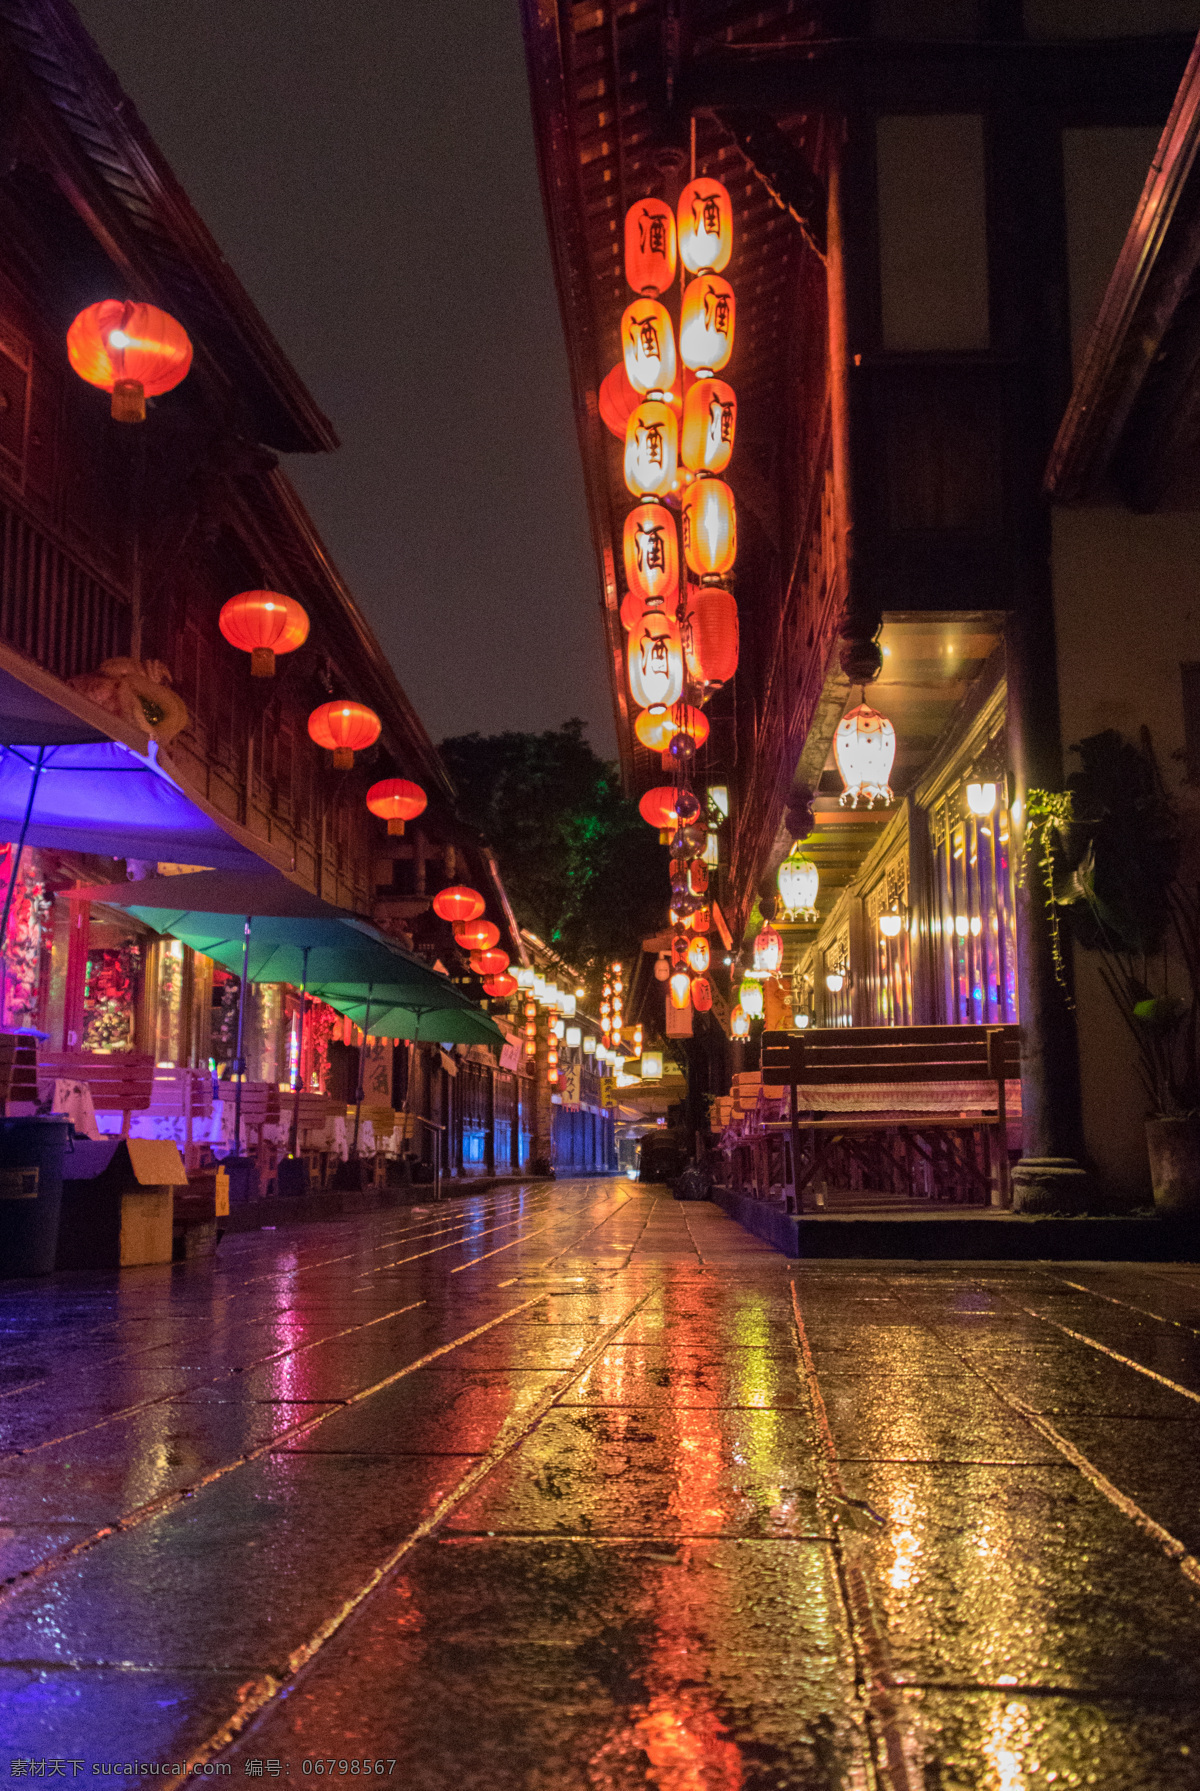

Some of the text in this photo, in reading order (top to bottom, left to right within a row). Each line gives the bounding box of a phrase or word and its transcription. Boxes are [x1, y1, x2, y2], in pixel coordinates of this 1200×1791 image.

[638, 208, 668, 260] 酒
[691, 191, 721, 239] 酒
[703, 284, 731, 338] 酒
[629, 315, 662, 362] 酒
[634, 418, 666, 470] 酒
[709, 391, 734, 449] 酒
[634, 521, 665, 574] 酒
[640, 627, 672, 680] 酒
